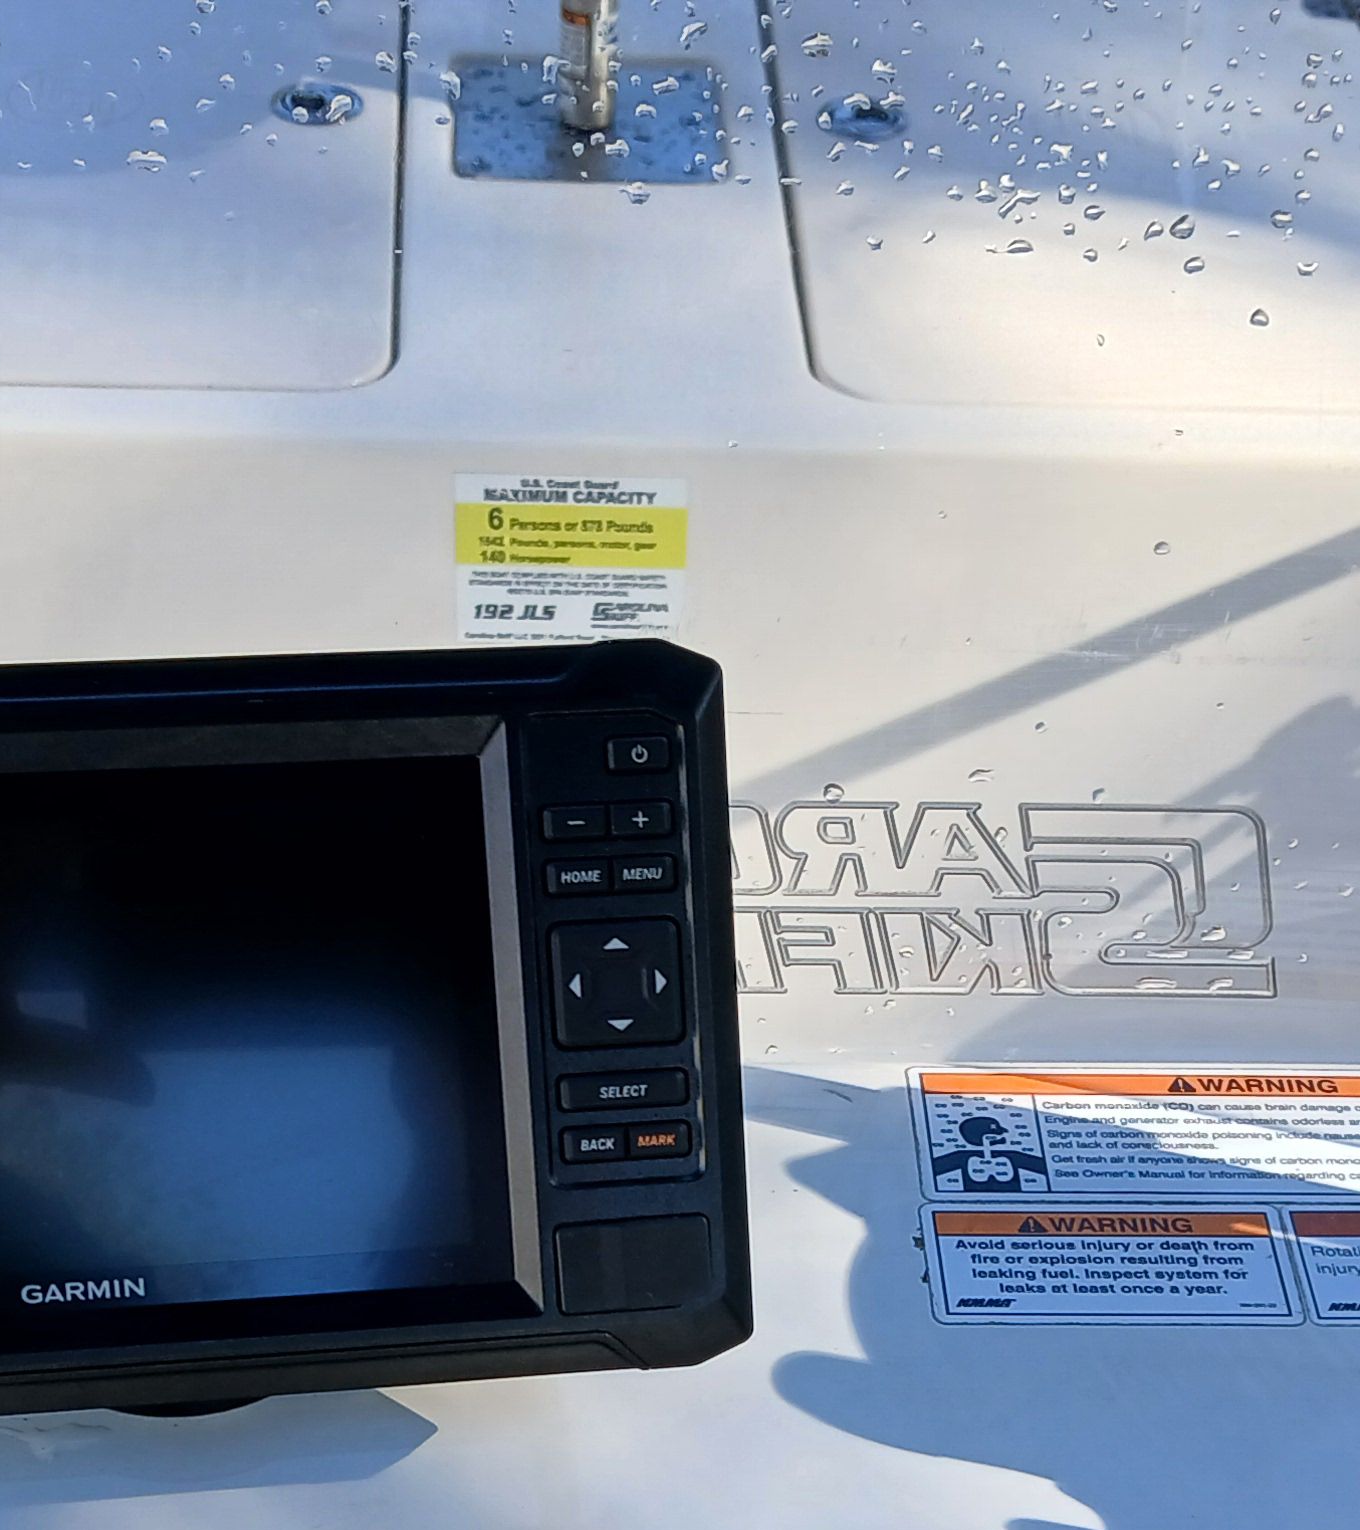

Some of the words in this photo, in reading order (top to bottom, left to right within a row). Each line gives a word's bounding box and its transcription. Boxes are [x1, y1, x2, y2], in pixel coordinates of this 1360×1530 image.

[483, 488, 568, 503] MAXIMUM
[573, 490, 657, 505] CAPACITY
[488, 507, 504, 530] 6
[509, 518, 561, 531] Persons
[564, 522, 578, 532] or
[606, 520, 654, 534] Pounds
[474, 604, 514, 619] 192
[517, 604, 557, 620] JLS
[561, 868, 601, 885] HOME
[622, 866, 662, 882] MENU
[599, 1084, 648, 1100] SELECT
[1197, 1078, 1339, 1094] WARNING
[1043, 1102, 1090, 1110] Carbon
[1095, 1102, 1159, 1110] monoxide
[1265, 1103, 1296, 1111] brain
[1300, 1104, 1351, 1113] damage
[1045, 1116, 1089, 1125] Engine
[1120, 1117, 1179, 1127] generator
[637, 1133, 676, 1148] MARK
[1047, 1130, 1082, 1140] Signs
[1101, 1130, 1144, 1138] carbon
[1212, 1131, 1272, 1141] poisoning
[581, 1136, 615, 1153] BACK
[1049, 1141, 1073, 1149] and
[1077, 1141, 1102, 1149] lack
[1052, 1155, 1073, 1164] Get
[1077, 1155, 1107, 1164] fresh
[1138, 1157, 1183, 1166] anyone
[1082, 1170, 1135, 1178] Owner's
[1139, 1171, 1185, 1179] Manual
[1209, 1171, 1281, 1179] information
[1284, 1172, 1345, 1181] regarding
[1048, 1217, 1194, 1233] WARNING
[956, 1240, 1005, 1250] Avoid
[1011, 1240, 1076, 1250] serious
[1081, 1240, 1131, 1253] injury
[1136, 1242, 1154, 1250] or
[1160, 1241, 1208, 1251] death
[1213, 1241, 1254, 1251] from
[971, 1254, 1000, 1264] fire
[1004, 1256, 1024, 1264] or
[1028, 1254, 1115, 1266] explosion
[1120, 1255, 1198, 1267] resulting
[1203, 1255, 1244, 1265] from
[972, 1268, 1037, 1281] leaking
[1041, 1268, 1080, 1279] fuel.
[1085, 1269, 1150, 1281] Inspect
[1155, 1270, 1219, 1281] system
[1223, 1269, 1249, 1279] for
[21, 1278, 146, 1304] GARMIN
[999, 1283, 1046, 1293] leaks
[1051, 1284, 1068, 1293] at
[1073, 1284, 1116, 1294] least
[1120, 1285, 1165, 1294] once
[1169, 1285, 1180, 1294] a
[1184, 1285, 1228, 1296] year.
